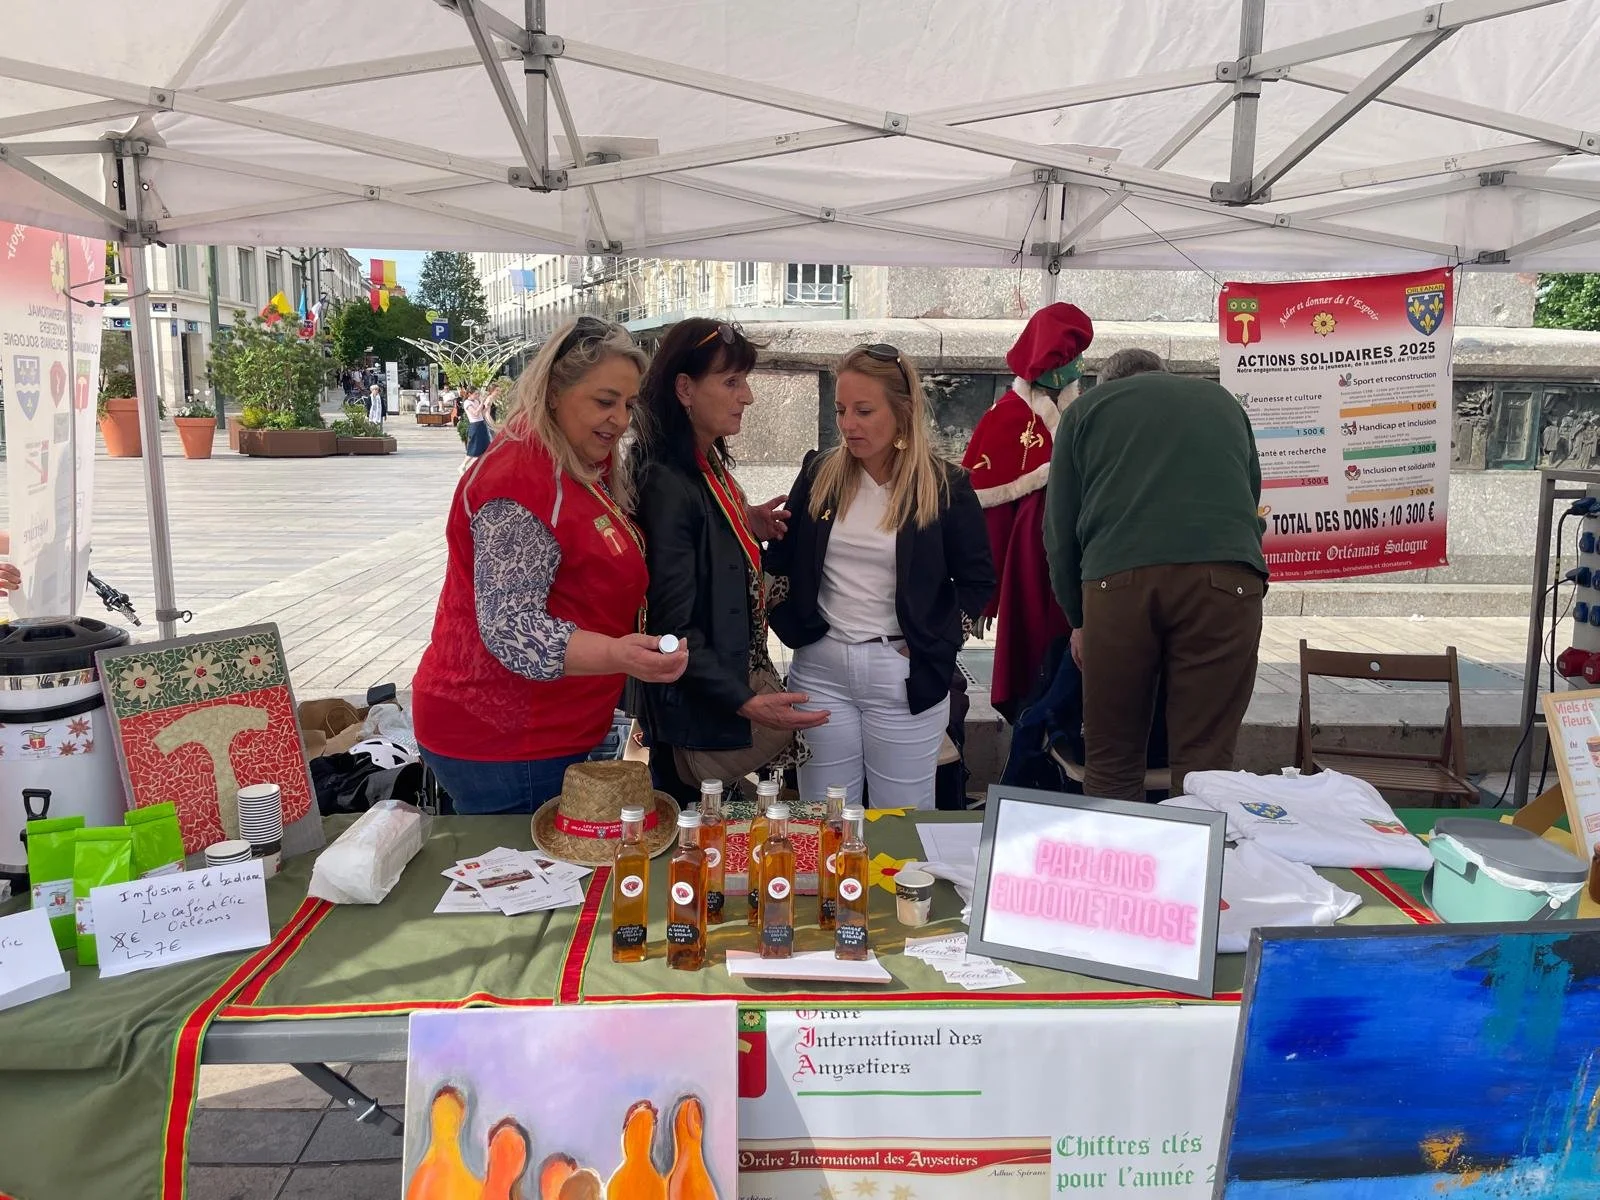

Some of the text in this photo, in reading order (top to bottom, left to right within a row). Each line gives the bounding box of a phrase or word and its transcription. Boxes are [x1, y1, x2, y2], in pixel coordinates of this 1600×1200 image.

[1279, 294, 1379, 328] Aider et donner de l'Espoir
[435, 325, 445, 337] P
[1237, 341, 1436, 367] ACTIONS SOLIDAIRES 2025
[1353, 377, 1374, 386] Sport
[1384, 372, 1437, 382] reconstruction
[1250, 395, 1284, 403] Jeunesse
[1294, 393, 1322, 401] culture
[1417, 401, 1431, 410] 000
[1303, 428, 1318, 436] 500
[1319, 427, 1325, 435] €
[1359, 422, 1397, 432] Handicap
[1407, 419, 1437, 427] inclusion
[1288, 446, 1327, 456] recherche
[1418, 444, 1431, 454] 300
[1362, 461, 1436, 475] Inclusion et solidarité
[1306, 477, 1323, 486] 500
[1415, 487, 1429, 496] 000
[1429, 486, 1435, 494] €
[1272, 500, 1435, 536] TOTAL DES DONS : 10 300 €
[1326, 542, 1380, 561] Orléanais
[1384, 539, 1429, 555] Sologne
[1381, 560, 1412, 568] donateurs
[1554, 699, 1594, 715] Miels de
[1562, 715, 1592, 728] Fleurs
[1035, 840, 1156, 891] PARLONS
[141, 909, 167, 924] Les
[991, 874, 1198, 945] ENDOMETRIOSE
[794, 1026, 983, 1054] International des
[792, 1054, 912, 1083] Anysetiers
[1056, 1130, 1204, 1159] Chiffres clés
[738, 1150, 979, 1168] Ordre International des Anysetiers
[1016, 1168, 1047, 1178] Spirans
[1056, 1169, 1107, 1193] pour
[1117, 1163, 1195, 1189] l'année
